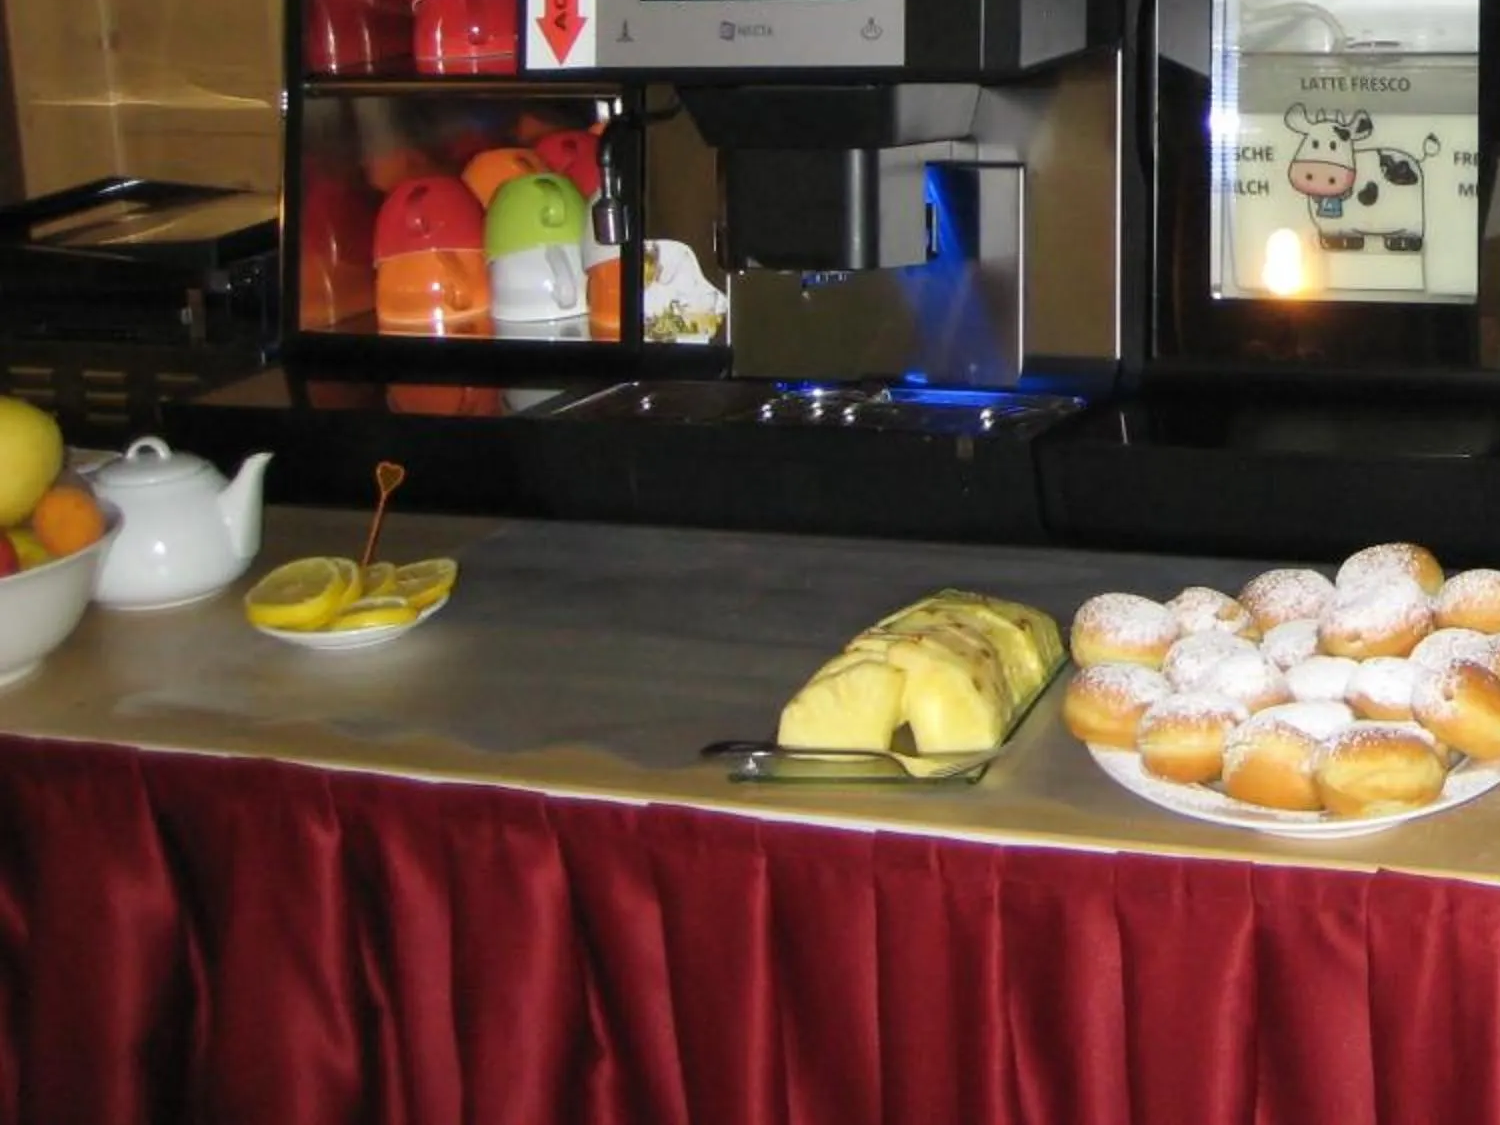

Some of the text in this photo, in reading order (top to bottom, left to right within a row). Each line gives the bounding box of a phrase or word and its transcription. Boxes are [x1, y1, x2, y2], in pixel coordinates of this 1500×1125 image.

[1300, 76, 1412, 93] LATTE FRESCO
[1232, 146, 1275, 163] SCHE
[1235, 179, 1270, 196] LCH
